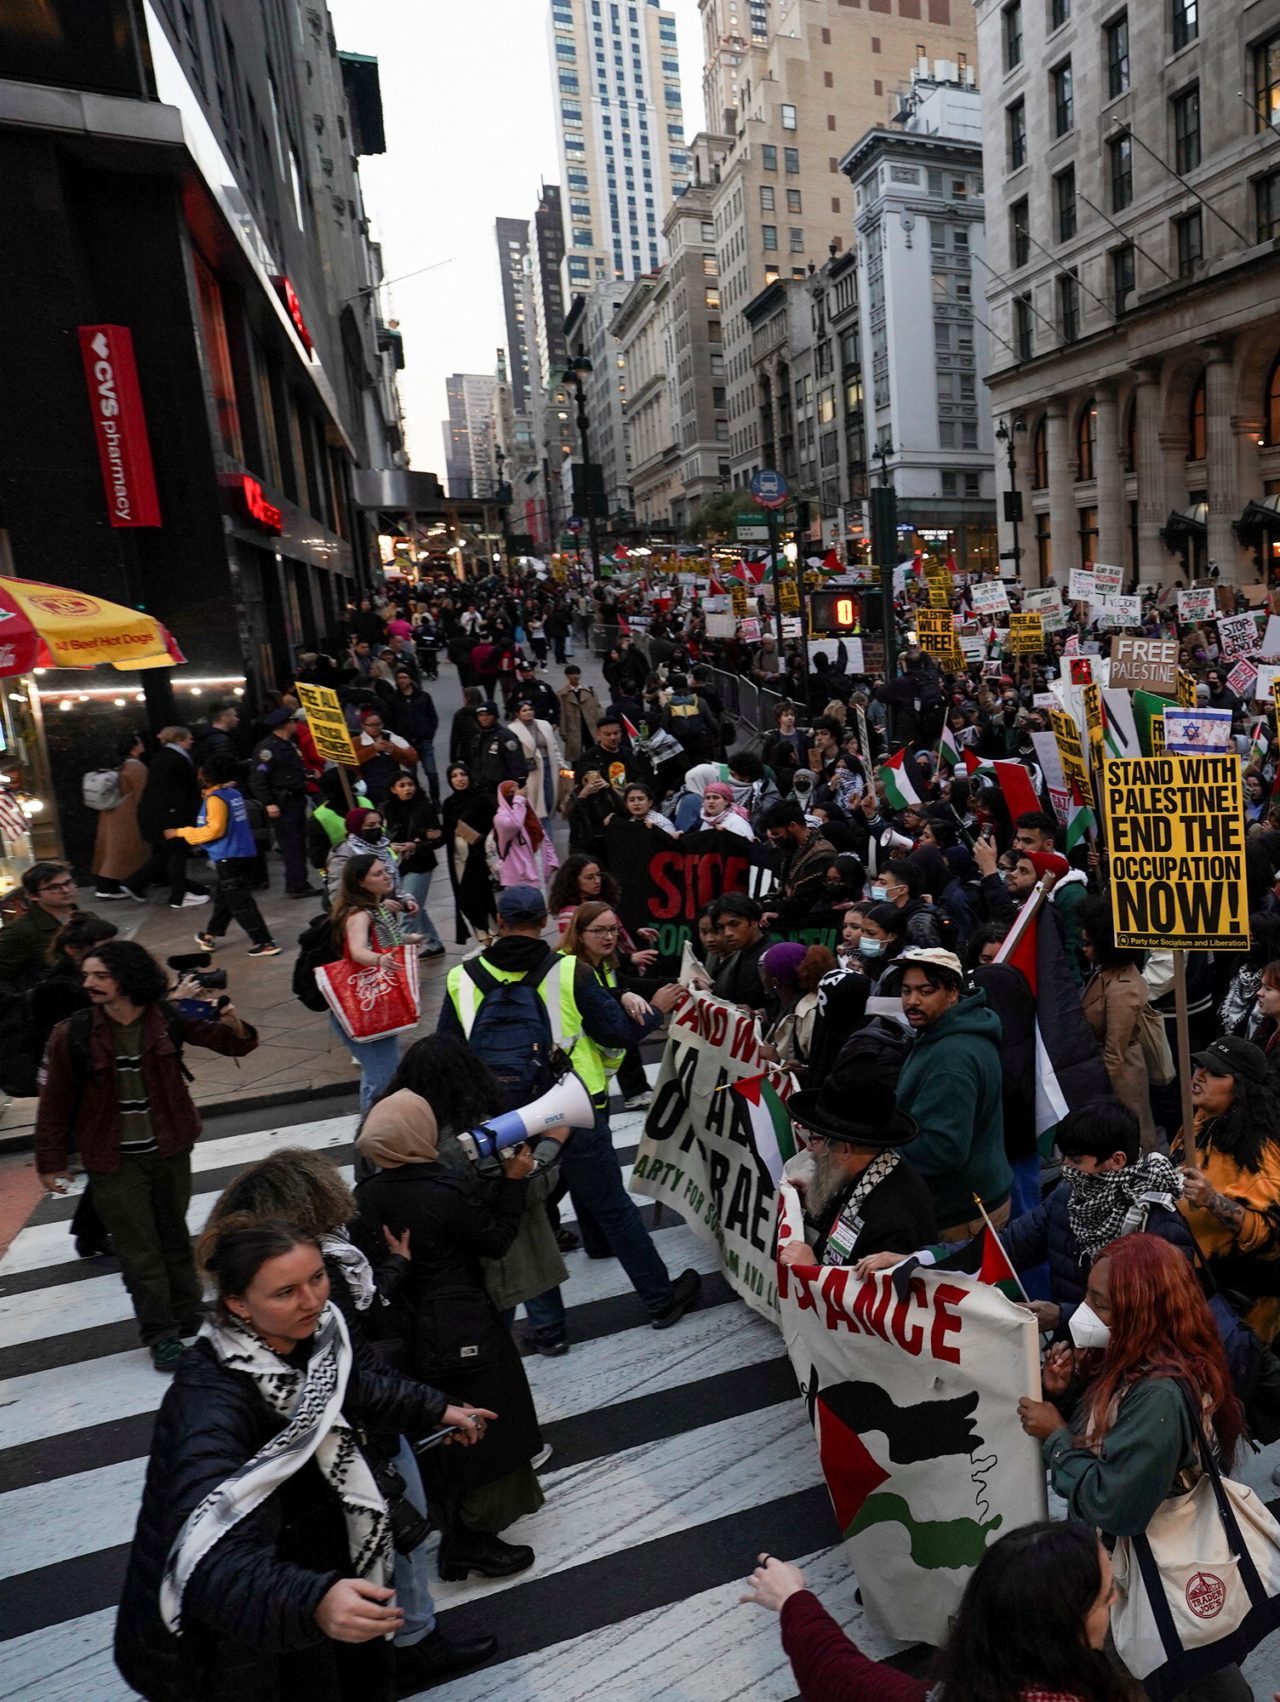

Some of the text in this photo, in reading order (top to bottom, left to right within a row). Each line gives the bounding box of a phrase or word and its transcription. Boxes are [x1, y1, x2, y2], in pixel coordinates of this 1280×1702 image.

[94, 360, 132, 521] CVS pharmacy
[919, 621, 937, 632] WILL
[1011, 615, 1028, 624] FREE
[1029, 615, 1041, 624] ALL
[1222, 618, 1251, 637] STOP
[70, 638, 100, 650] Beef
[100, 636, 122, 647] Hot
[123, 633, 154, 645] Dogs
[920, 634, 952, 651] FREE!
[1229, 631, 1247, 643] THE
[1117, 639, 1177, 663] FREE
[1112, 661, 1175, 683] PALESTINE
[1237, 663, 1255, 678] GAZA
[1228, 674, 1244, 689] FREE
[1108, 759, 1173, 786] STAND
[1180, 758, 1237, 784] WITH
[1110, 785, 1238, 814] PALESTINE!
[1111, 814, 1241, 853] END THE
[1113, 856, 1241, 881] OCCUPATION
[1116, 880, 1240, 934] NOW!
[1130, 937, 1247, 947] Party for Socialism and Liberation
[633, 1153, 685, 1193] ARTY
[1191, 1590, 1223, 1607] TRADER
[1199, 1599, 1222, 1614] JOE'S
